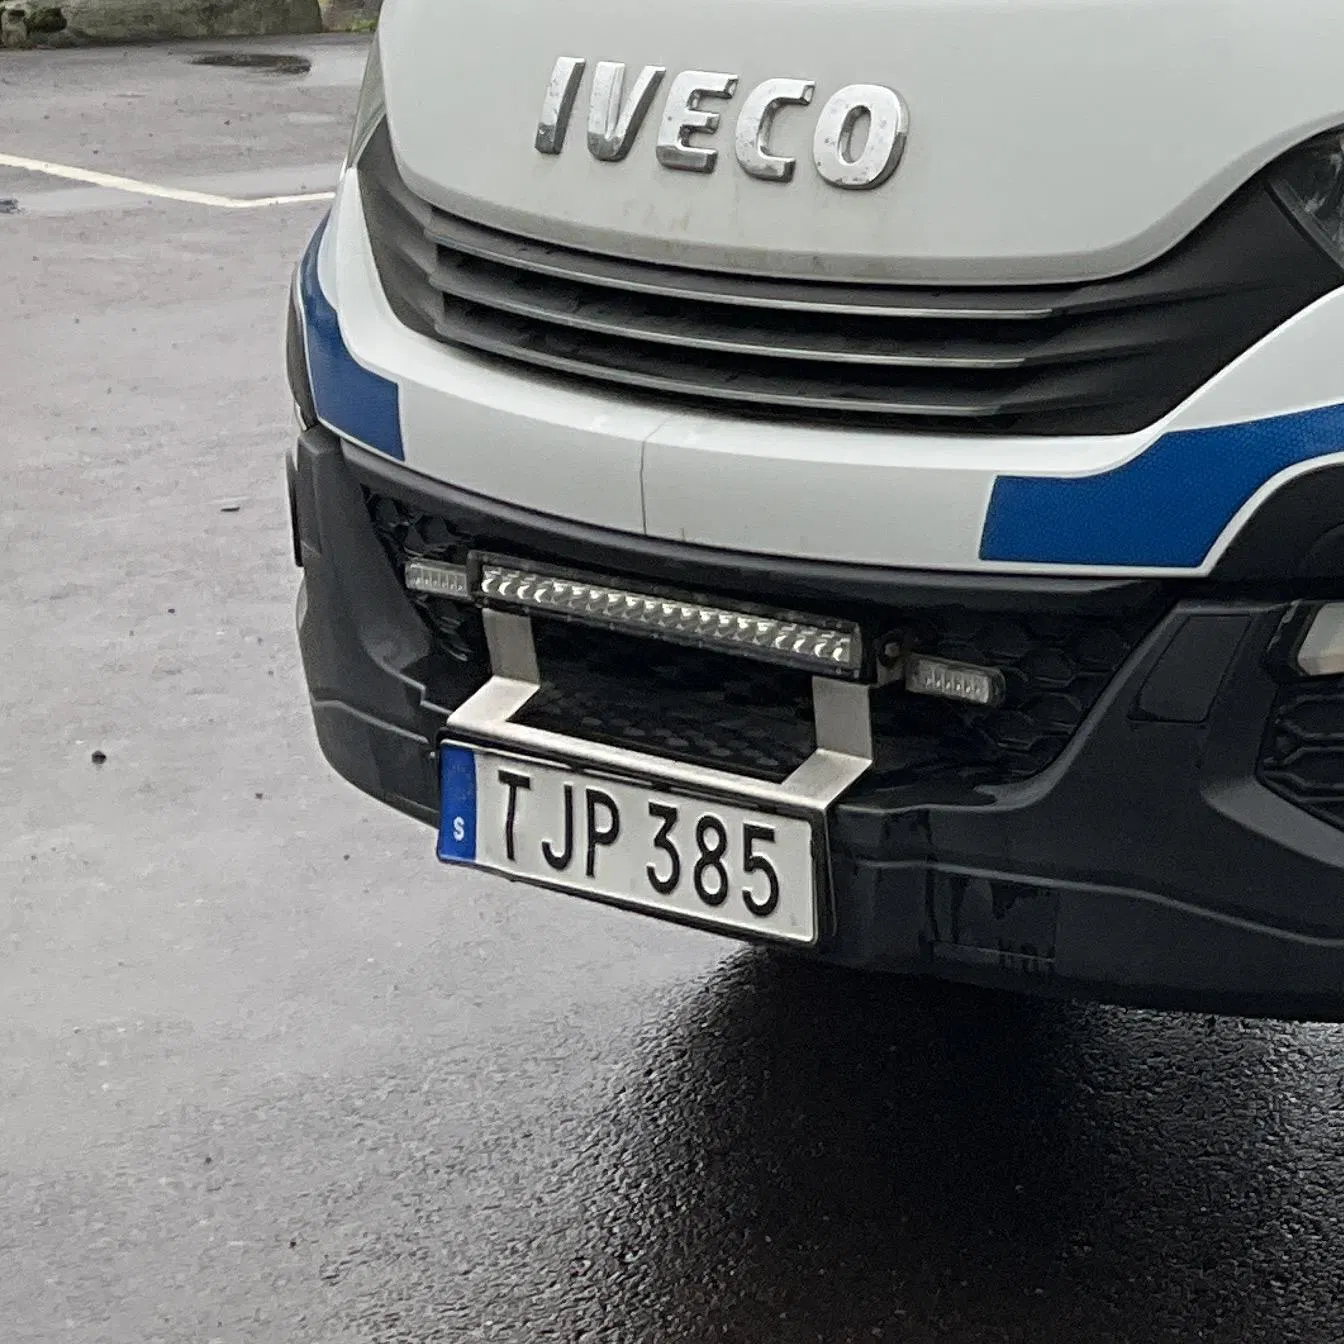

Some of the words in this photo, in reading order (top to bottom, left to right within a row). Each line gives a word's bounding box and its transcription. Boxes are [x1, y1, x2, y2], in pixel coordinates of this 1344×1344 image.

[534, 56, 910, 191] IVECO
[453, 816, 465, 842] S
[497, 769, 621, 878] TJP
[645, 801, 780, 917] 385
